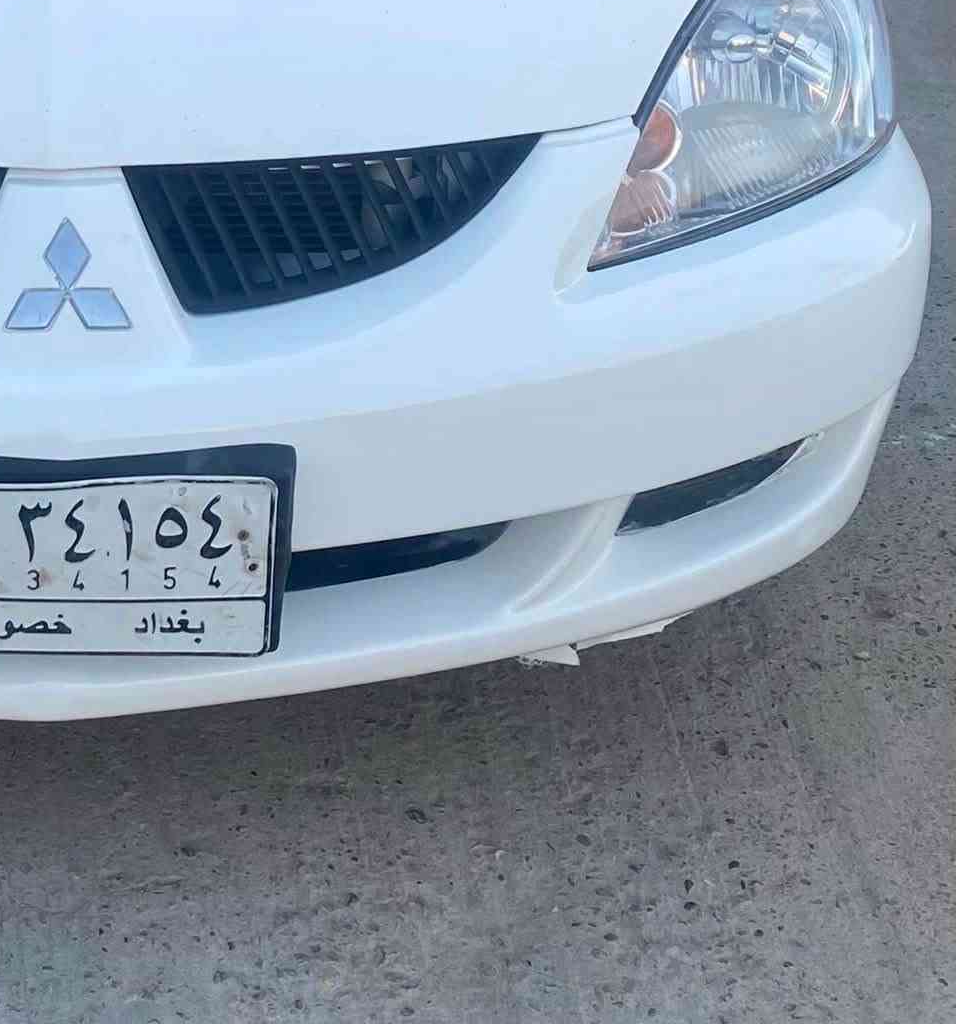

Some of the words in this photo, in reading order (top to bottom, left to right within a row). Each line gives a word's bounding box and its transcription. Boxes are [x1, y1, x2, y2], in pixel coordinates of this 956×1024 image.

[17, 493, 234, 564] ٣٤١٥٤
[26, 565, 221, 591] 34154
[134, 608, 206, 644] بغداد
